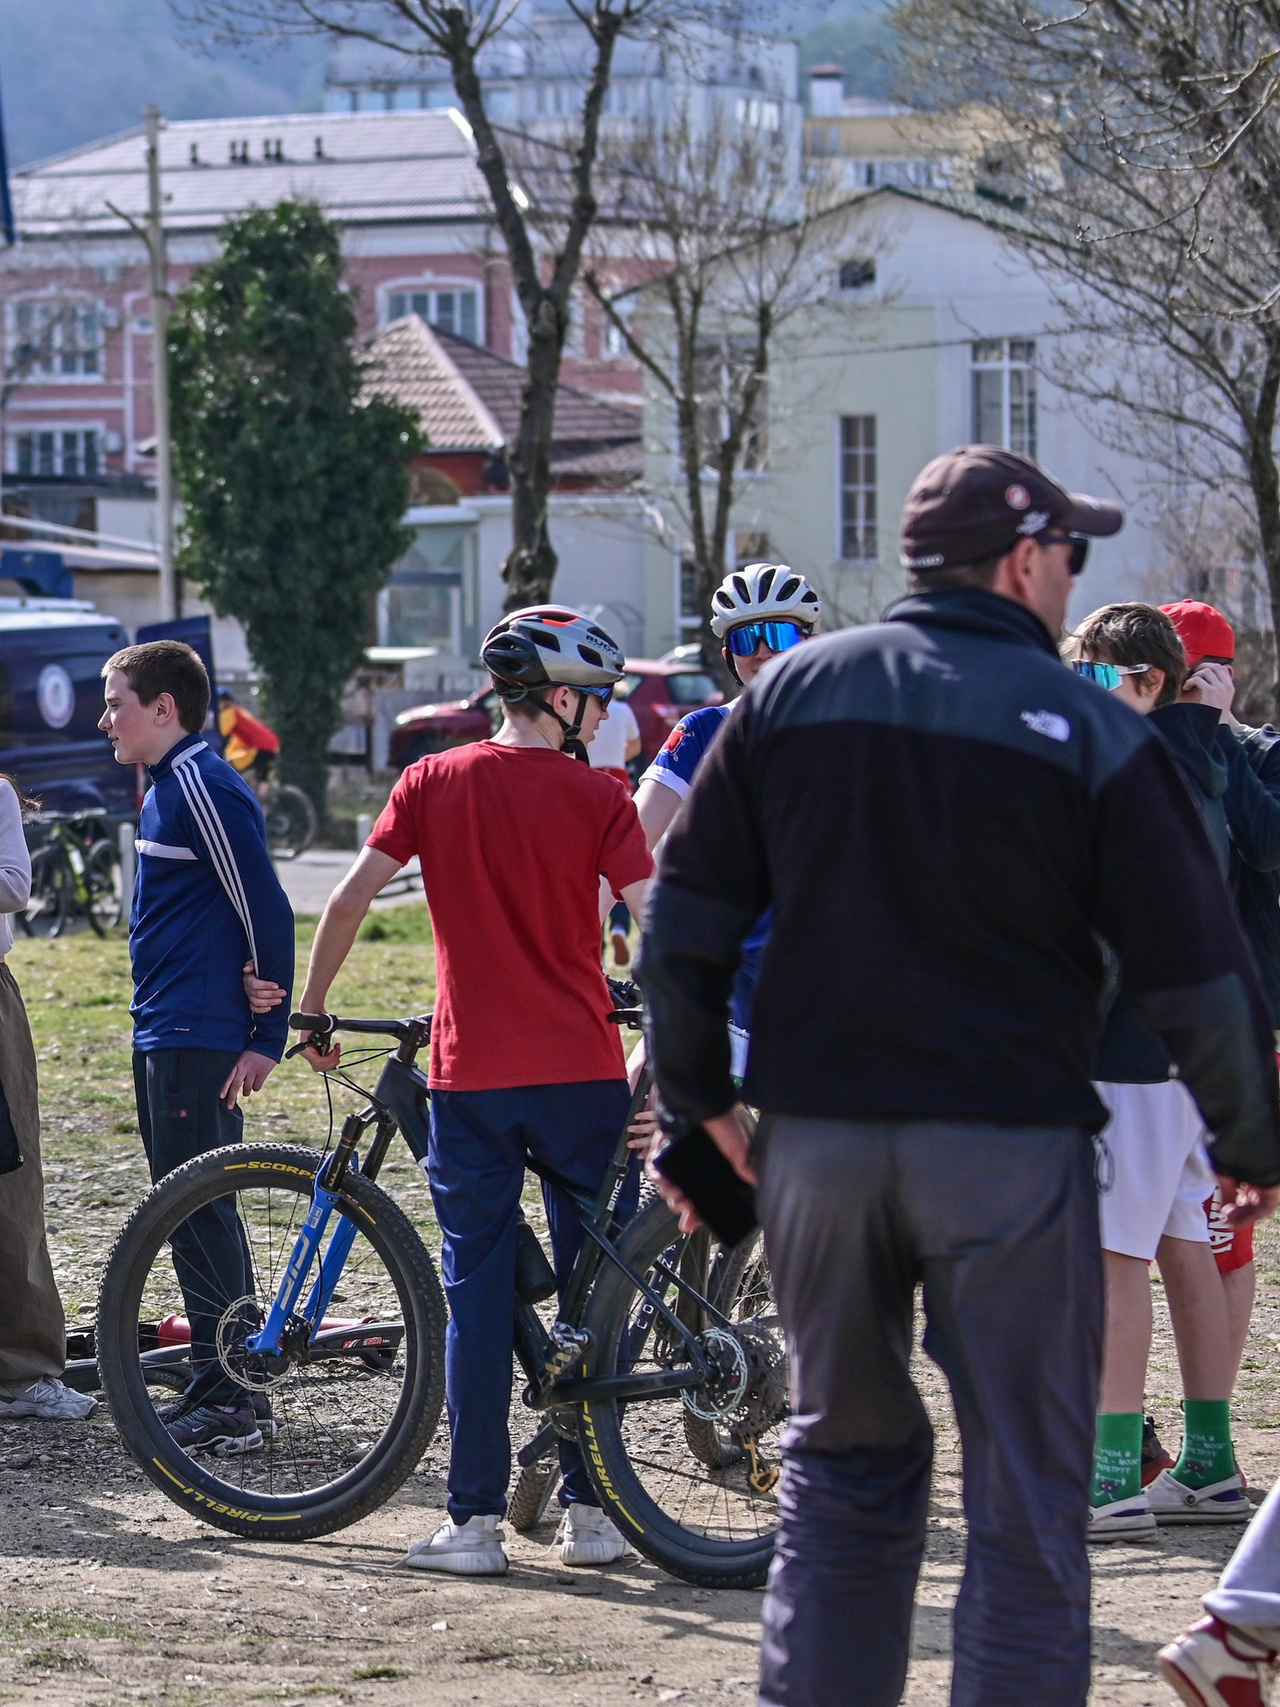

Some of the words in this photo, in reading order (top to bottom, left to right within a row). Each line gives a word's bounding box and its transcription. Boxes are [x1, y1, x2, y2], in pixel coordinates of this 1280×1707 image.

[586, 634, 617, 655] RUDY
[247, 1161, 316, 1180] SCORPI
[582, 1413, 620, 1501] PIRELLI
[183, 1488, 262, 1522] PIRELLI
